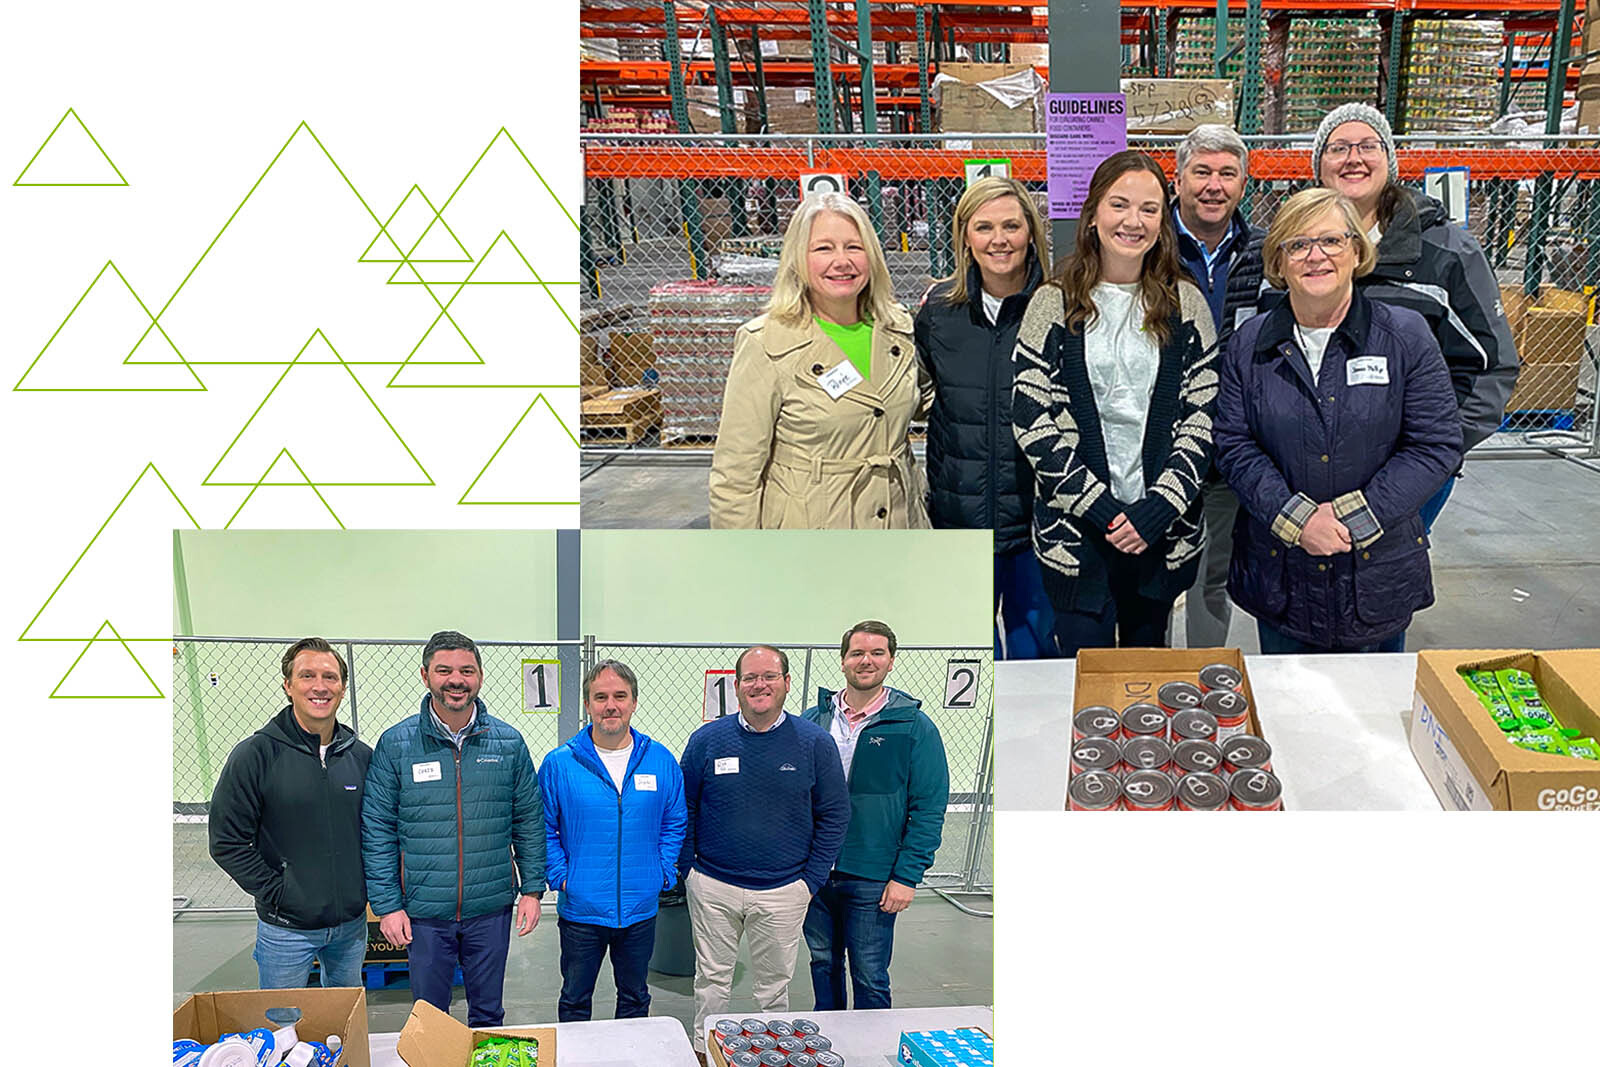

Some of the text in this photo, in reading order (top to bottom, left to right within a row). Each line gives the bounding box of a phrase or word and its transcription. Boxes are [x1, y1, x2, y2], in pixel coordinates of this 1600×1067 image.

[1049, 100, 1124, 114] GUIDELINES
[1435, 173, 1457, 221] 1
[531, 664, 552, 708] 1
[714, 677, 726, 719] 1
[948, 668, 975, 706] 2
[1537, 785, 1598, 811] GoGo
[371, 942, 394, 951] YOU
